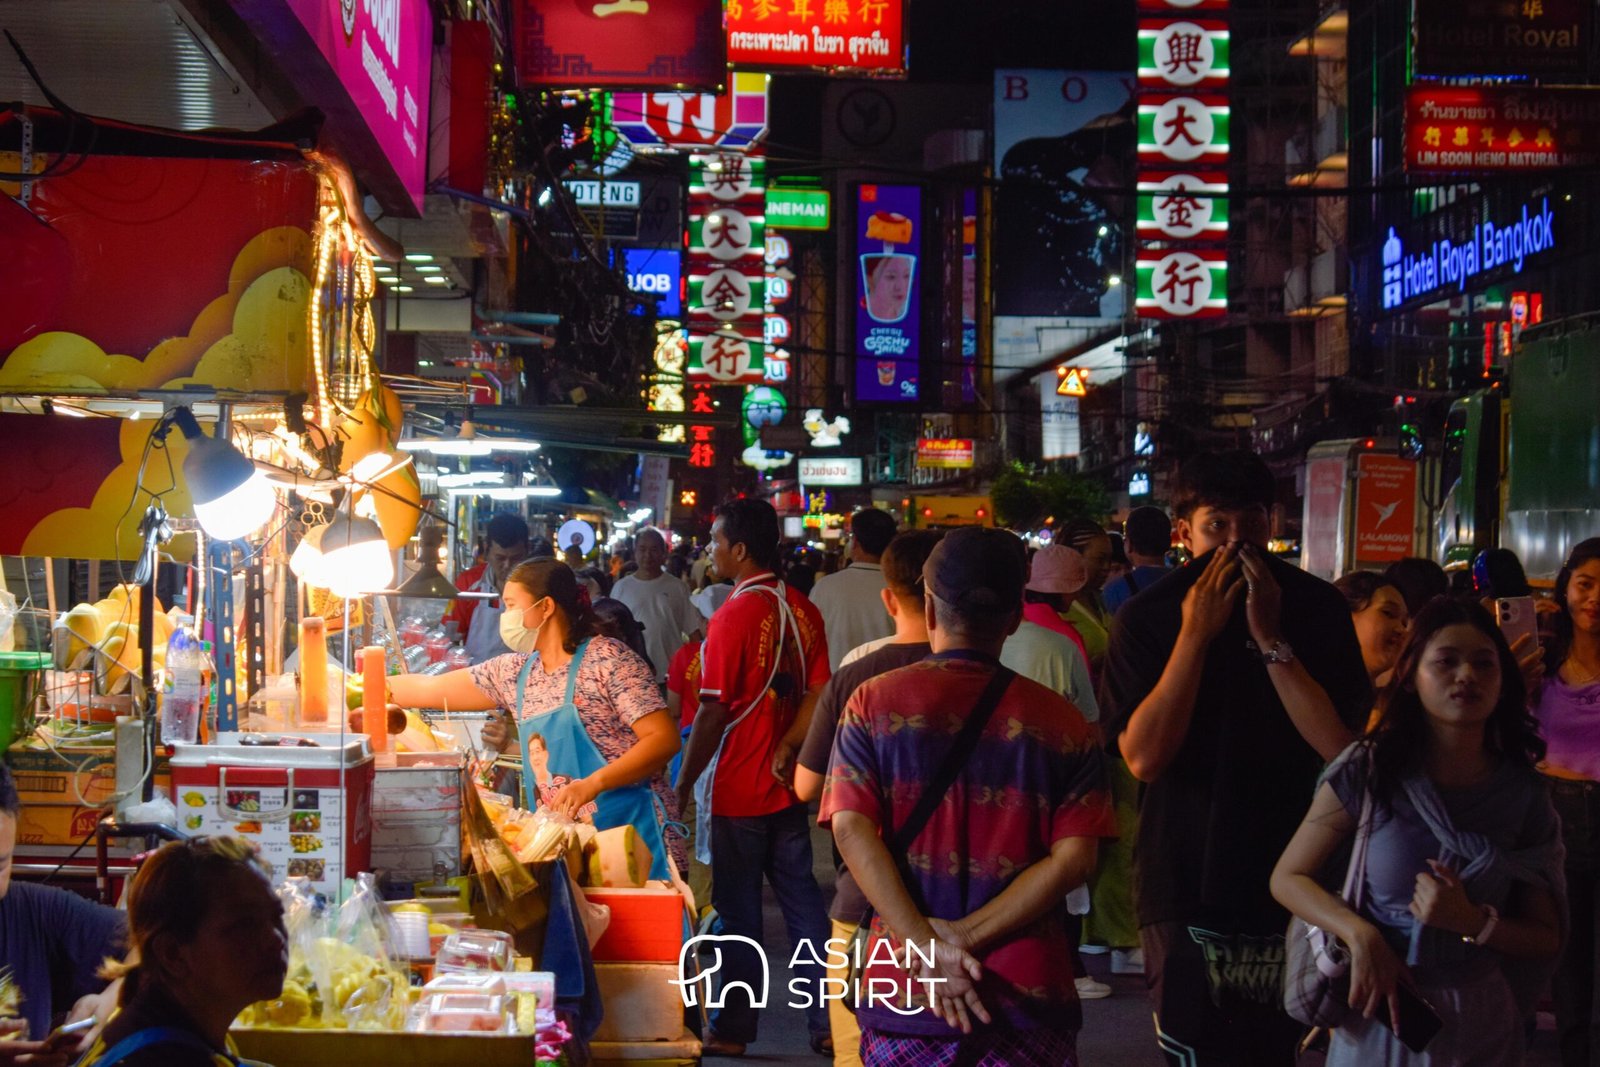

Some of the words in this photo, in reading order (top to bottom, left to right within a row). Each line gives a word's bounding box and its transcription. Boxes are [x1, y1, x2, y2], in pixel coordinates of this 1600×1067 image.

[1440, 151, 1473, 166] SOON
[1404, 240, 1438, 298] Hotel
[1440, 223, 1480, 292] Royal
[1482, 196, 1554, 274] Bangkok
[1359, 532, 1411, 543] LALAMOVE
